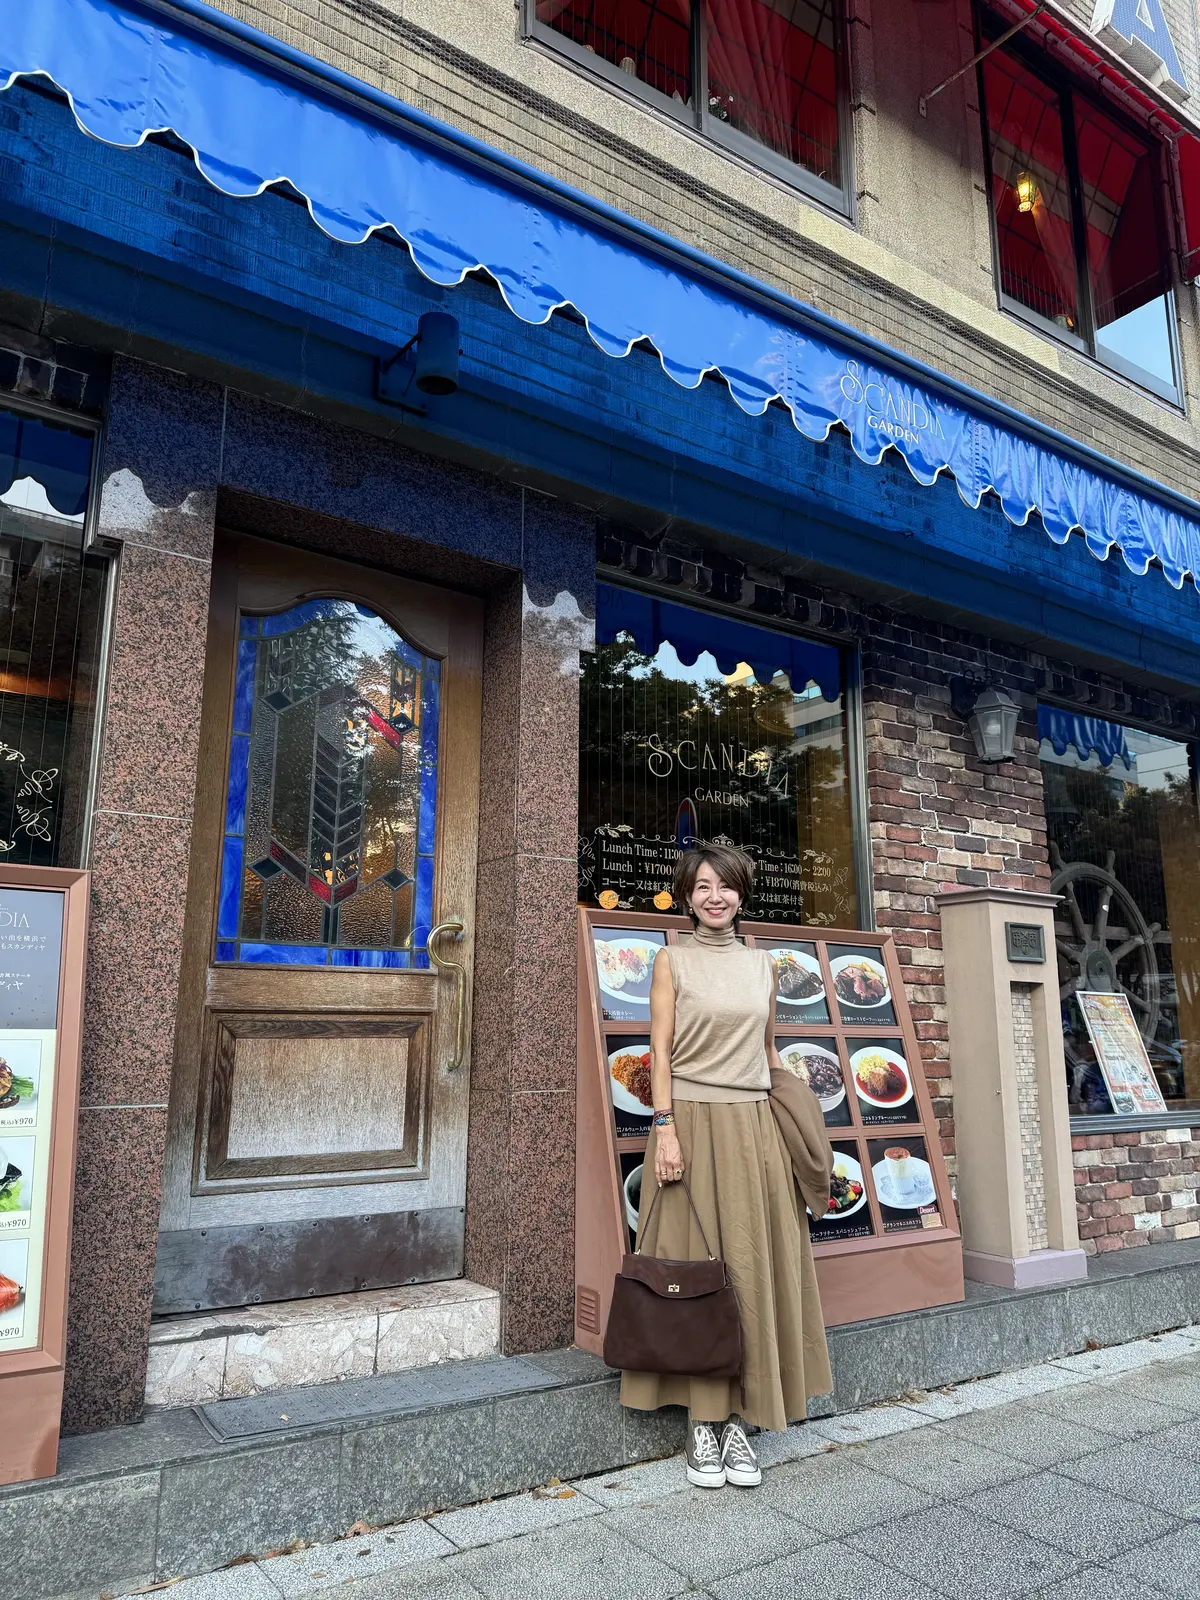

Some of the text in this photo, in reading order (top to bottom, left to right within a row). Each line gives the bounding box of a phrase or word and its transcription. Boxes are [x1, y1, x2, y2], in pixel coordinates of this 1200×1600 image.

[840, 359, 946, 441] SCANDIA
[867, 415, 919, 444] GARDEN
[647, 733, 792, 798] SCANDIA
[694, 787, 750, 808] GARDEN
[602, 839, 633, 855] Lunch
[602, 857, 633, 873] Lunch
